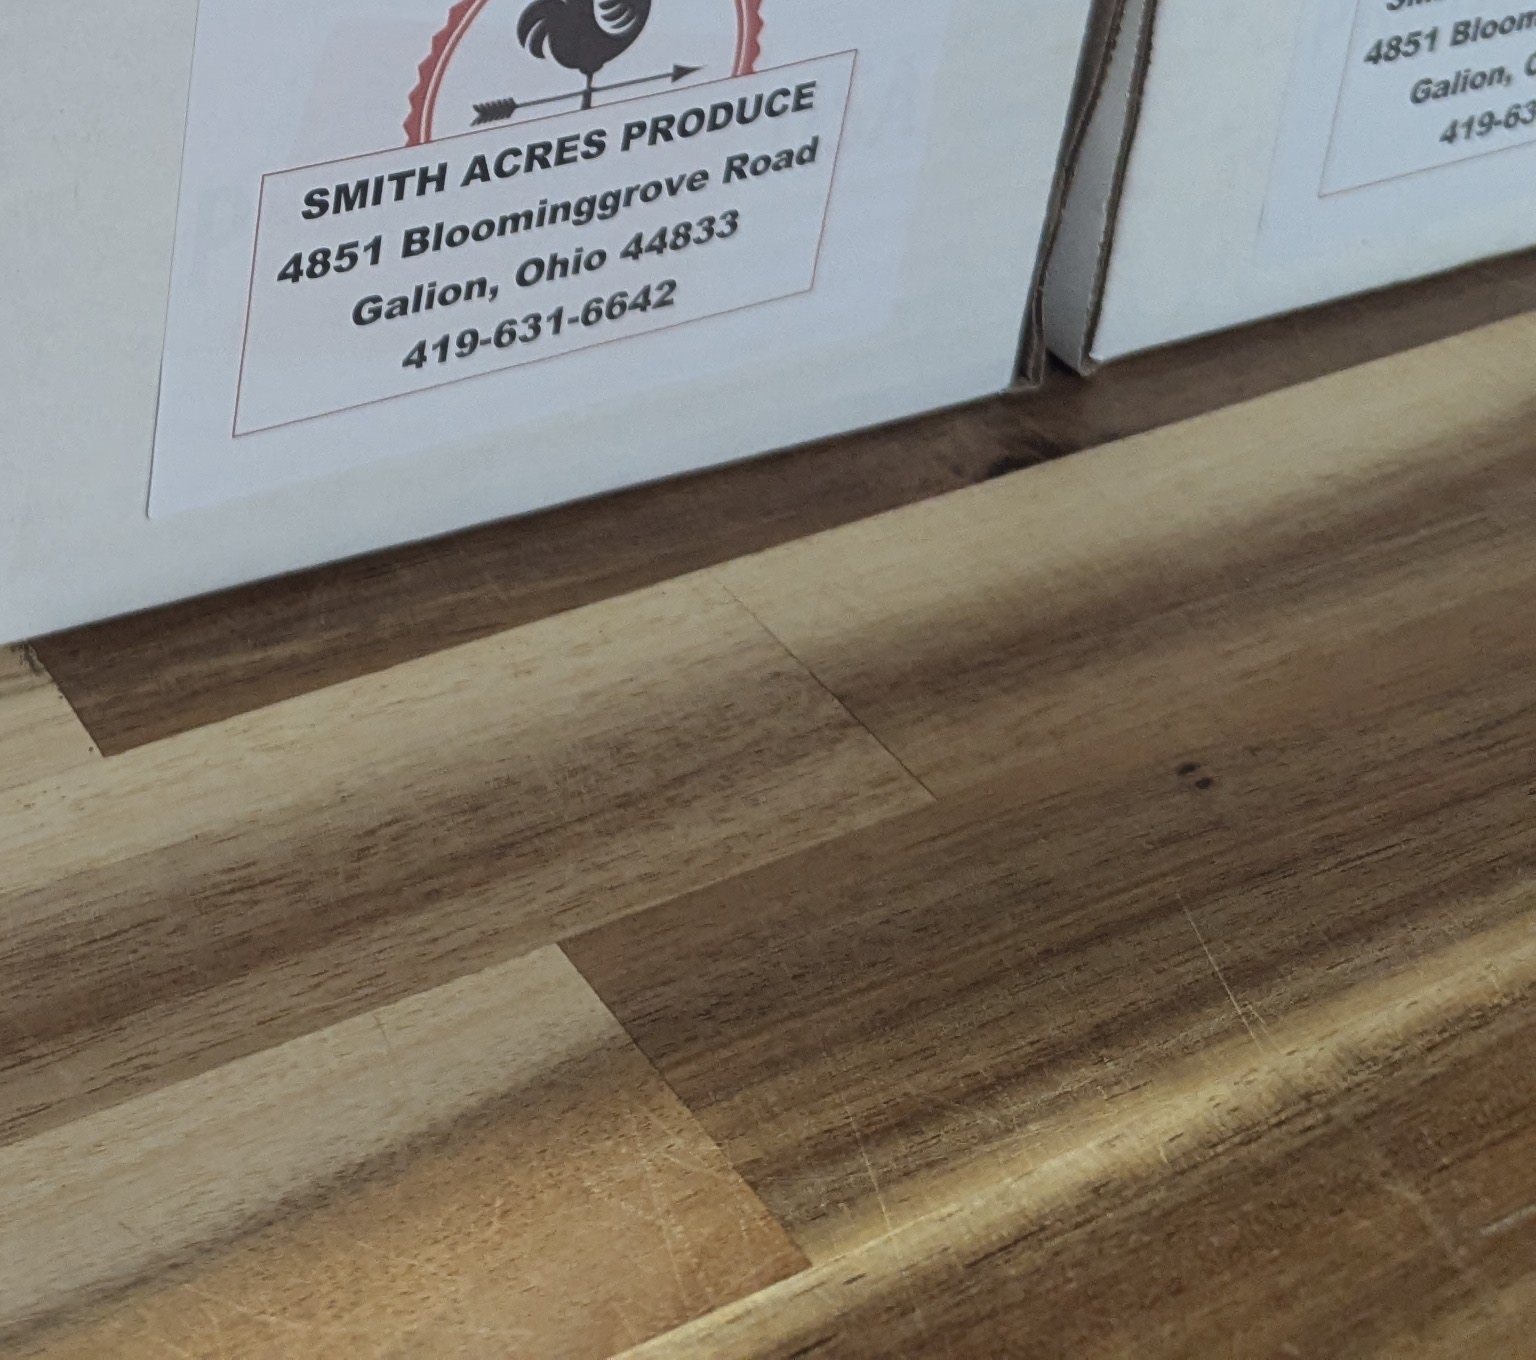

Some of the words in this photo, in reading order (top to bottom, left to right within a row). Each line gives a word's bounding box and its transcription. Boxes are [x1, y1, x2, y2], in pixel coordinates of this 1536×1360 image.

[1364, 27, 1438, 64] 4851
[1410, 67, 1512, 104] Galion,
[301, 162, 447, 219] SMITH
[460, 129, 606, 187] ACRES
[621, 81, 816, 151] PRODUCE
[277, 235, 382, 283] 4851
[401, 170, 709, 258] Bloominggrove
[722, 136, 819, 184] Road
[352, 277, 498, 326] Galion,
[515, 246, 607, 287] Ohio
[620, 210, 739, 260] 44833
[402, 277, 677, 368] 419-631-6642
